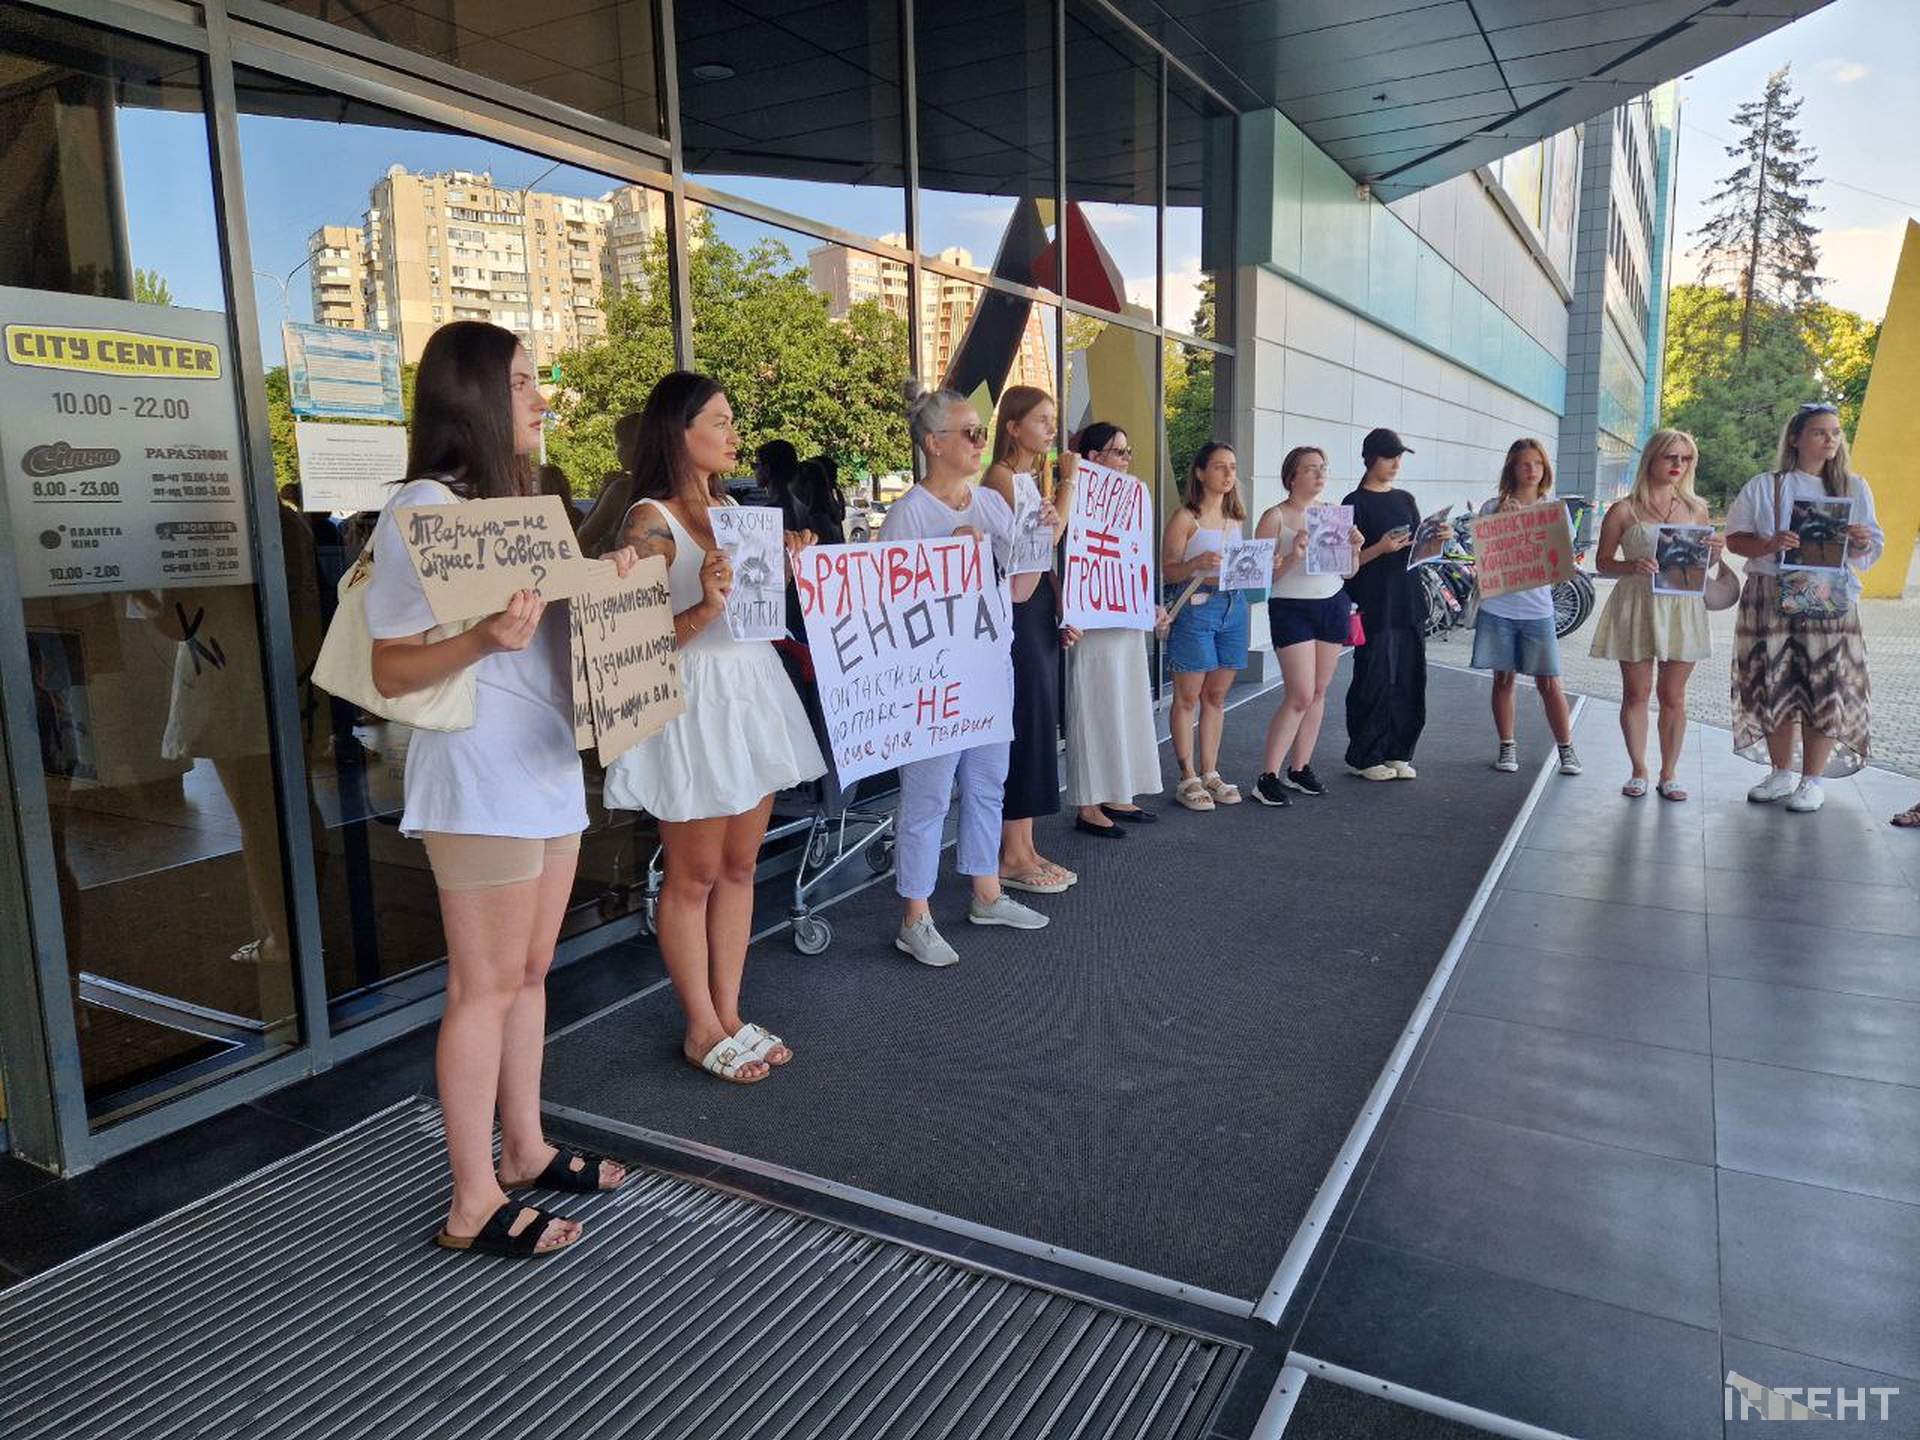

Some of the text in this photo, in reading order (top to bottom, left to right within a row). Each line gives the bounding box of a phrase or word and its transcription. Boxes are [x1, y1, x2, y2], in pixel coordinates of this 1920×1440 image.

[14, 332, 213, 371] CITY CENTER
[53, 392, 112, 416] 10.00
[134, 396, 190, 419] 22.00
[33, 481, 66, 496] 8.00
[79, 481, 119, 496] 23.00
[720, 512, 774, 531] Я ХОЧУ
[49, 566, 83, 580] 10.00
[94, 564, 120, 577] 2.00
[826, 648, 949, 714] ОНТАКТНИЙ
[916, 681, 962, 726] НЕ
